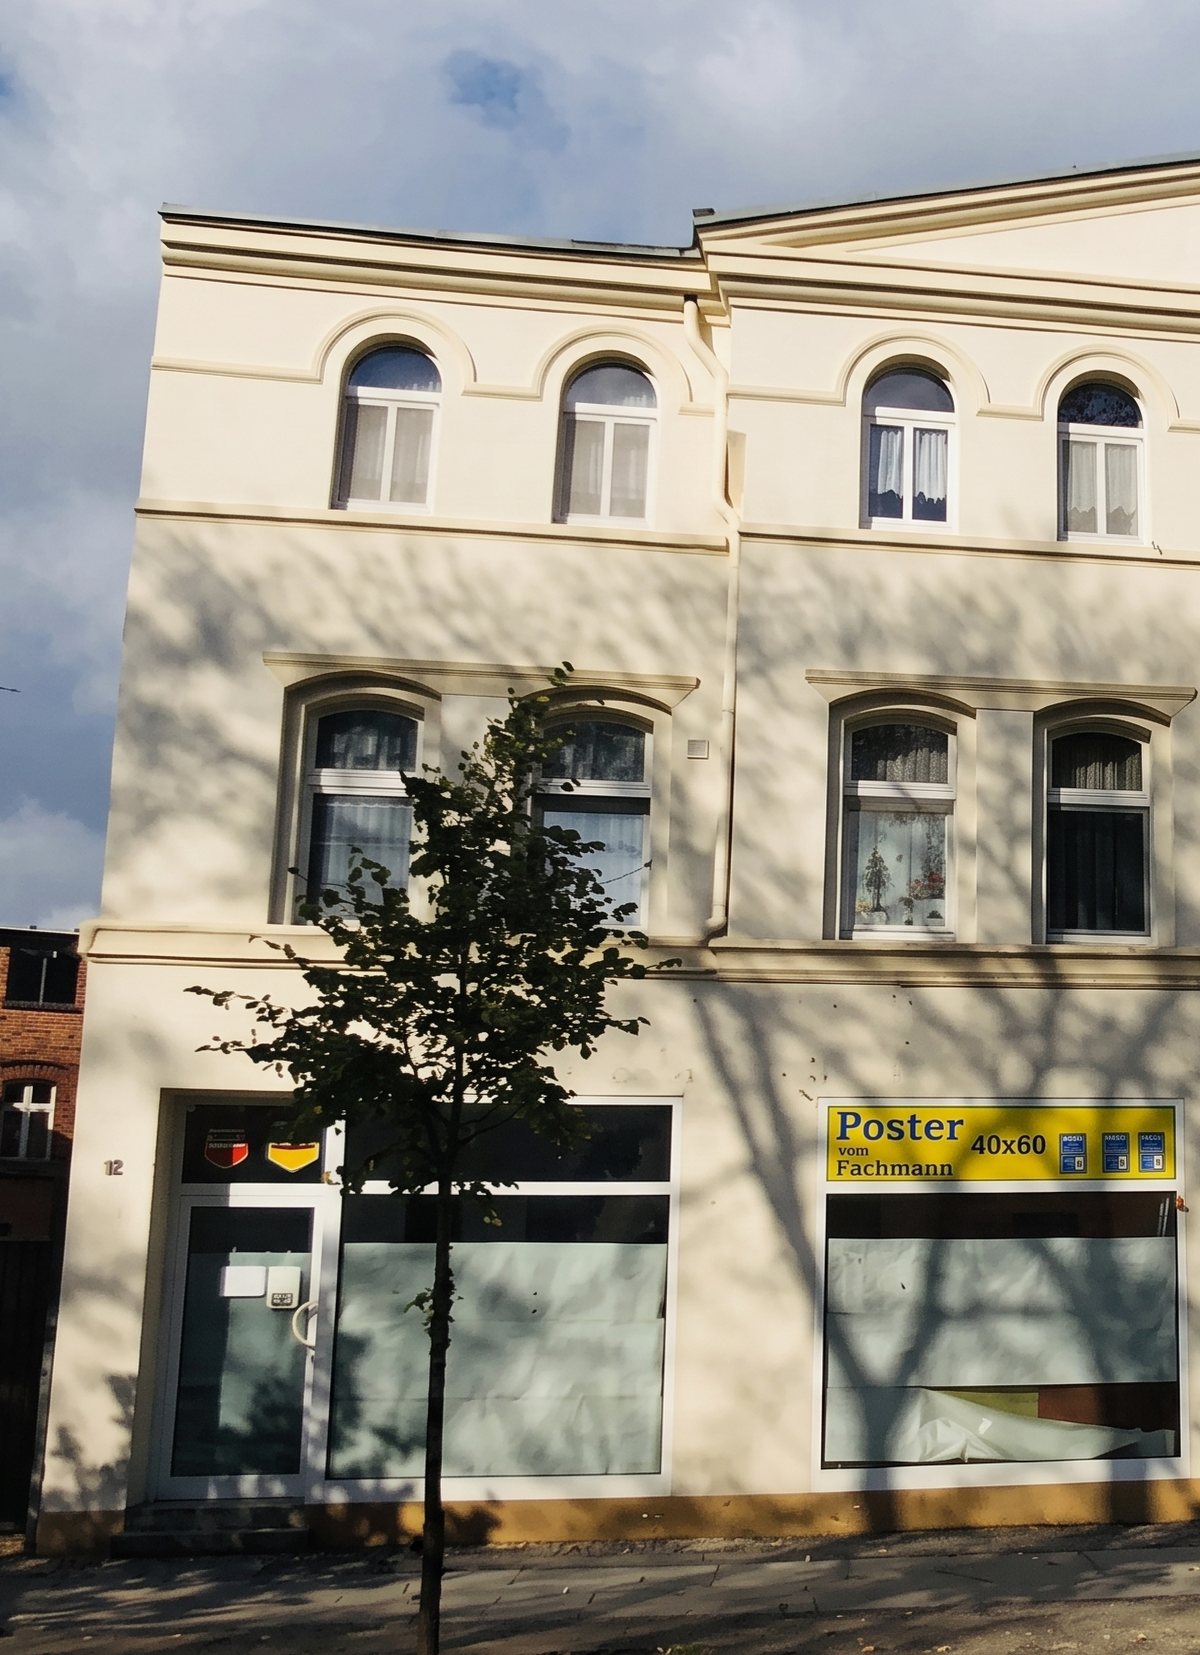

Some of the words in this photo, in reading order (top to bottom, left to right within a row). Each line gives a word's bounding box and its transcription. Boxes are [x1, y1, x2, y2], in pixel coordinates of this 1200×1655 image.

[836, 1111, 964, 1141] Poster
[838, 1145, 869, 1157] vom
[971, 1134, 1046, 1155] 40x60
[103, 1159, 124, 1176] 12
[836, 1159, 953, 1177] Fachmann
